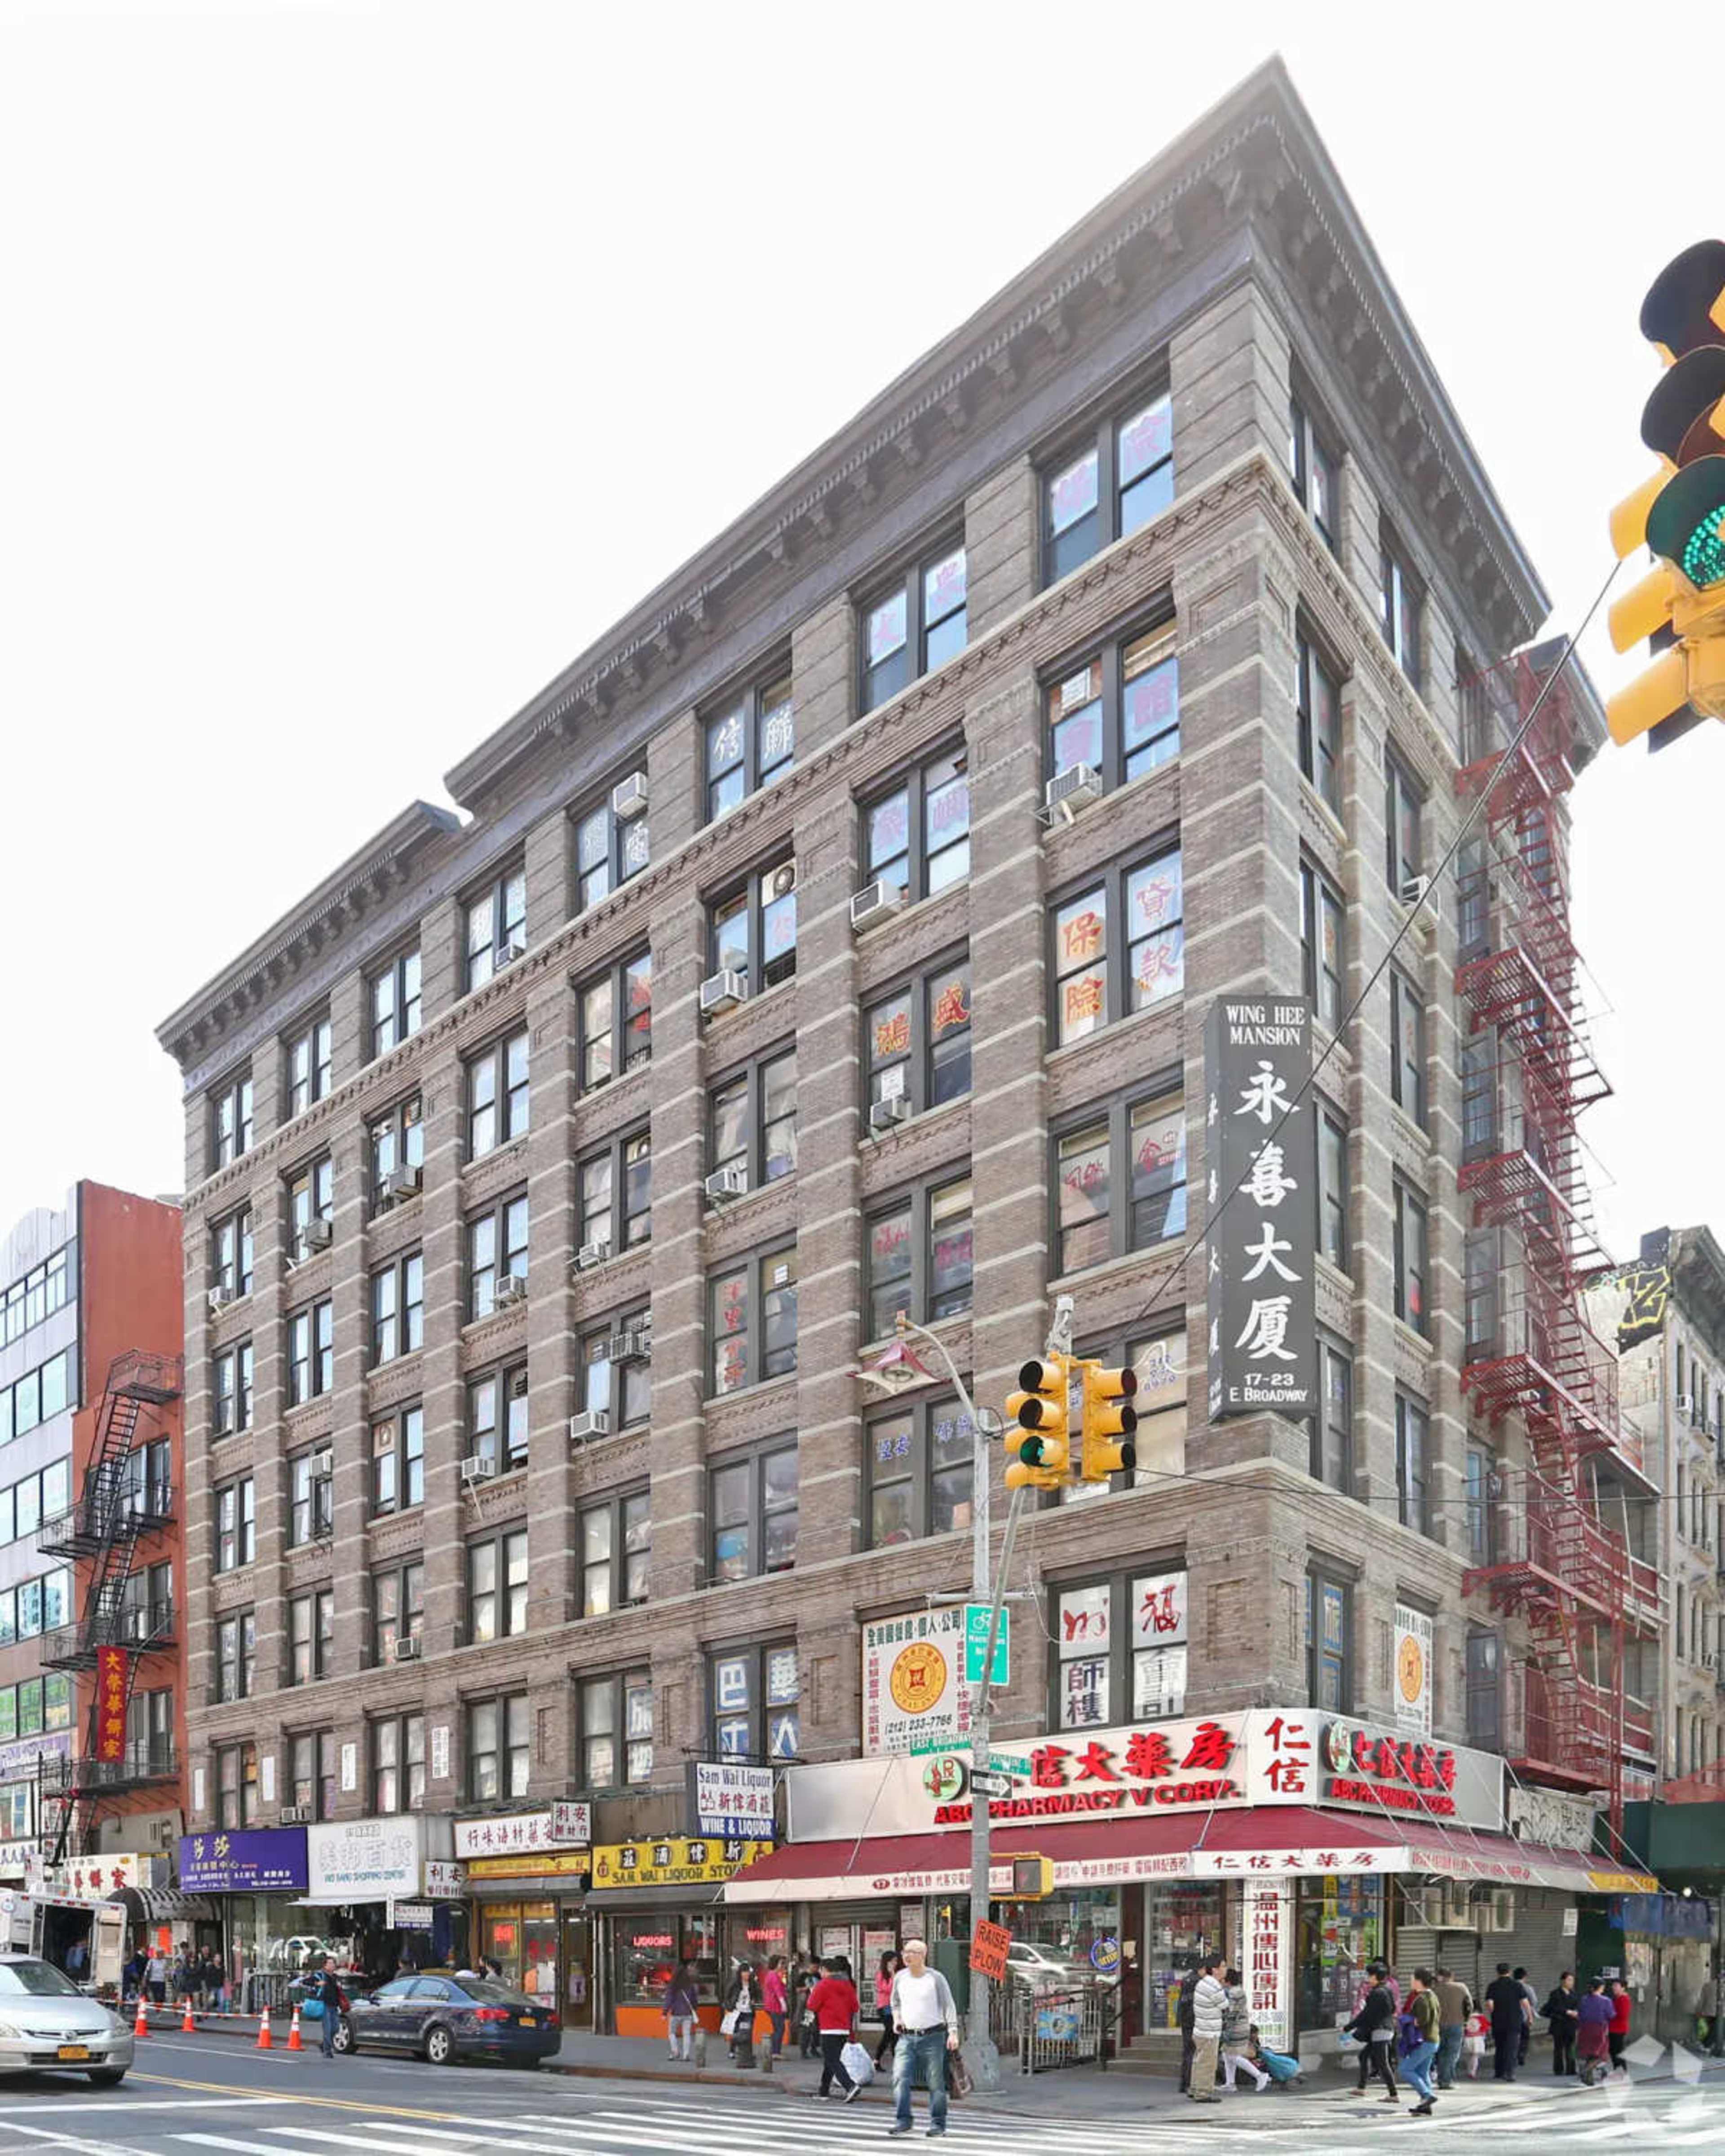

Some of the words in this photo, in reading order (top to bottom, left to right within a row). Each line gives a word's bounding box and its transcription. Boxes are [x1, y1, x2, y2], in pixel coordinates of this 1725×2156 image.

[1226, 1005, 1264, 1024] WING
[1275, 1007, 1305, 1026] HEE
[1230, 1027, 1301, 1046] MANSION
[1244, 1372, 1294, 1386] 17-23
[1244, 1387, 1307, 1402] BROADWAY
[1013, 1722, 1236, 1789] 信大藥房
[1265, 1717, 1311, 1793] 仁信
[699, 1767, 719, 1785] Sam
[723, 1769, 739, 1786] Wai
[741, 1771, 770, 1791] Liquor
[701, 1817, 725, 1833] WINE
[728, 1819, 735, 1834] &
[739, 1819, 772, 1837] LIQUOR
[663, 1865, 703, 1881] LIQUOR
[710, 1860, 748, 1878] STO
[633, 1935, 672, 1946] LIQUORS
[746, 1928, 787, 1940] WINES
[977, 1926, 1007, 1951] RAISE
[974, 1953, 1002, 1973] PLOW
